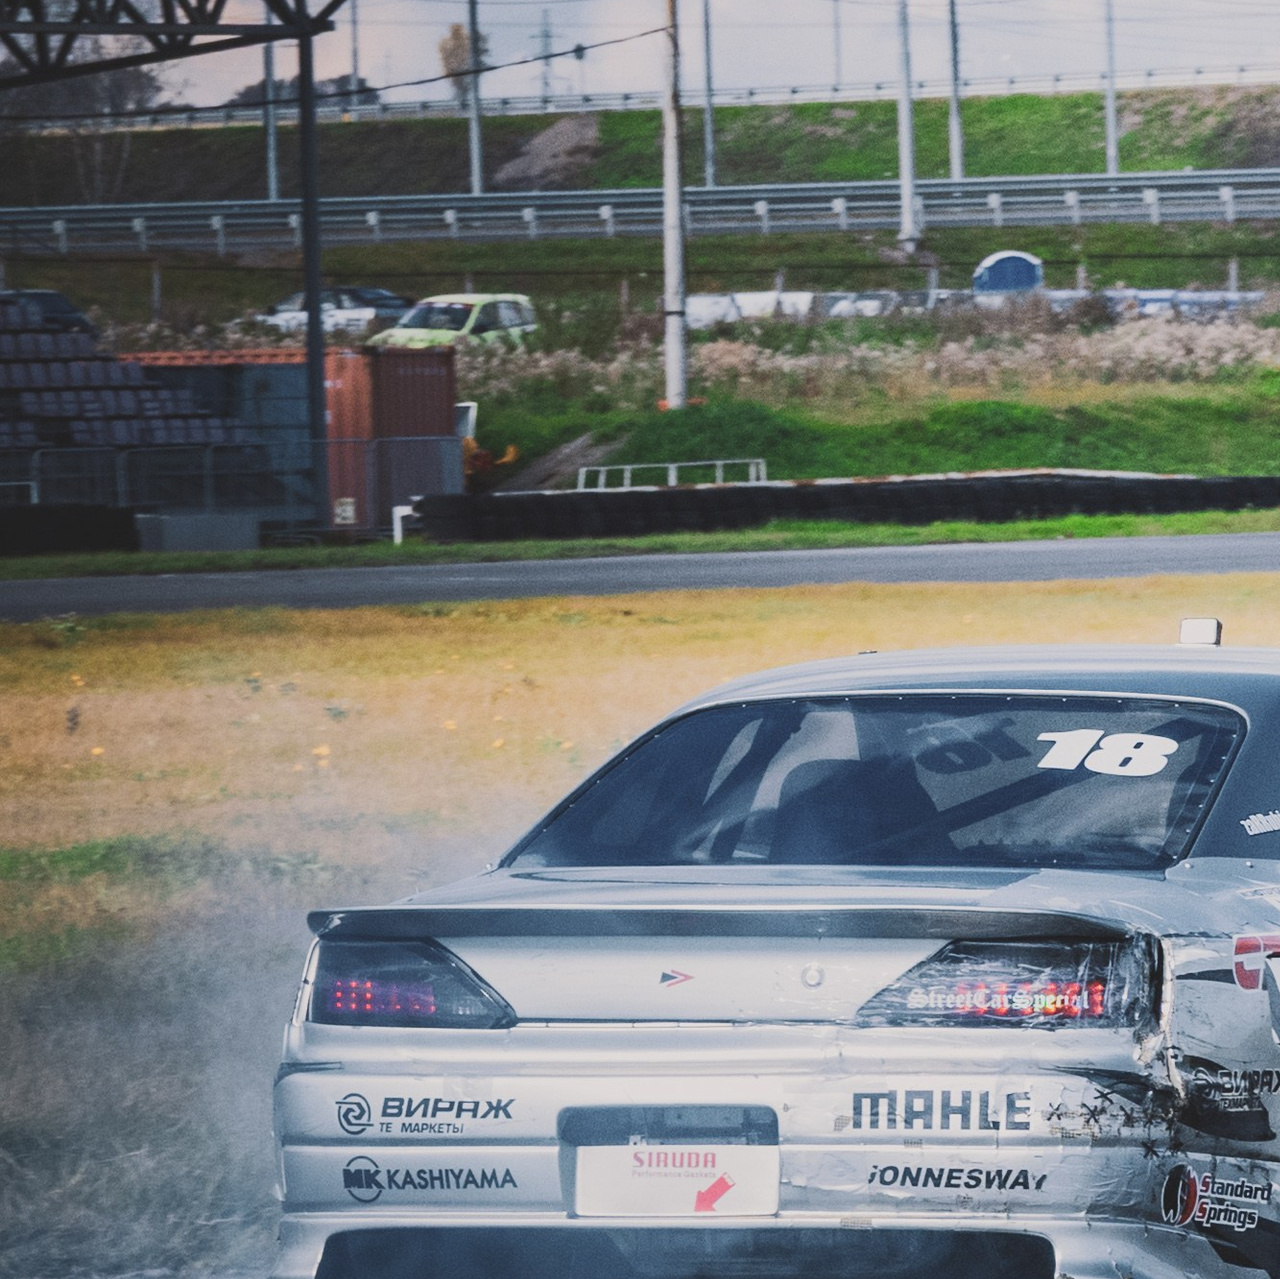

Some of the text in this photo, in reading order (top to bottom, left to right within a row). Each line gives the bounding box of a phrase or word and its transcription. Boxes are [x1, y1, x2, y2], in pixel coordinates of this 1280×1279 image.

[1036, 728, 1179, 776] 18
[381, 1097, 516, 1119] ВИРАЖ
[852, 1090, 1031, 1131] MAHLE
[386, 1168, 518, 1189] KASHIYAMA
[1199, 1172, 1273, 1204] Standard
[1195, 1199, 1258, 1232] Springs
